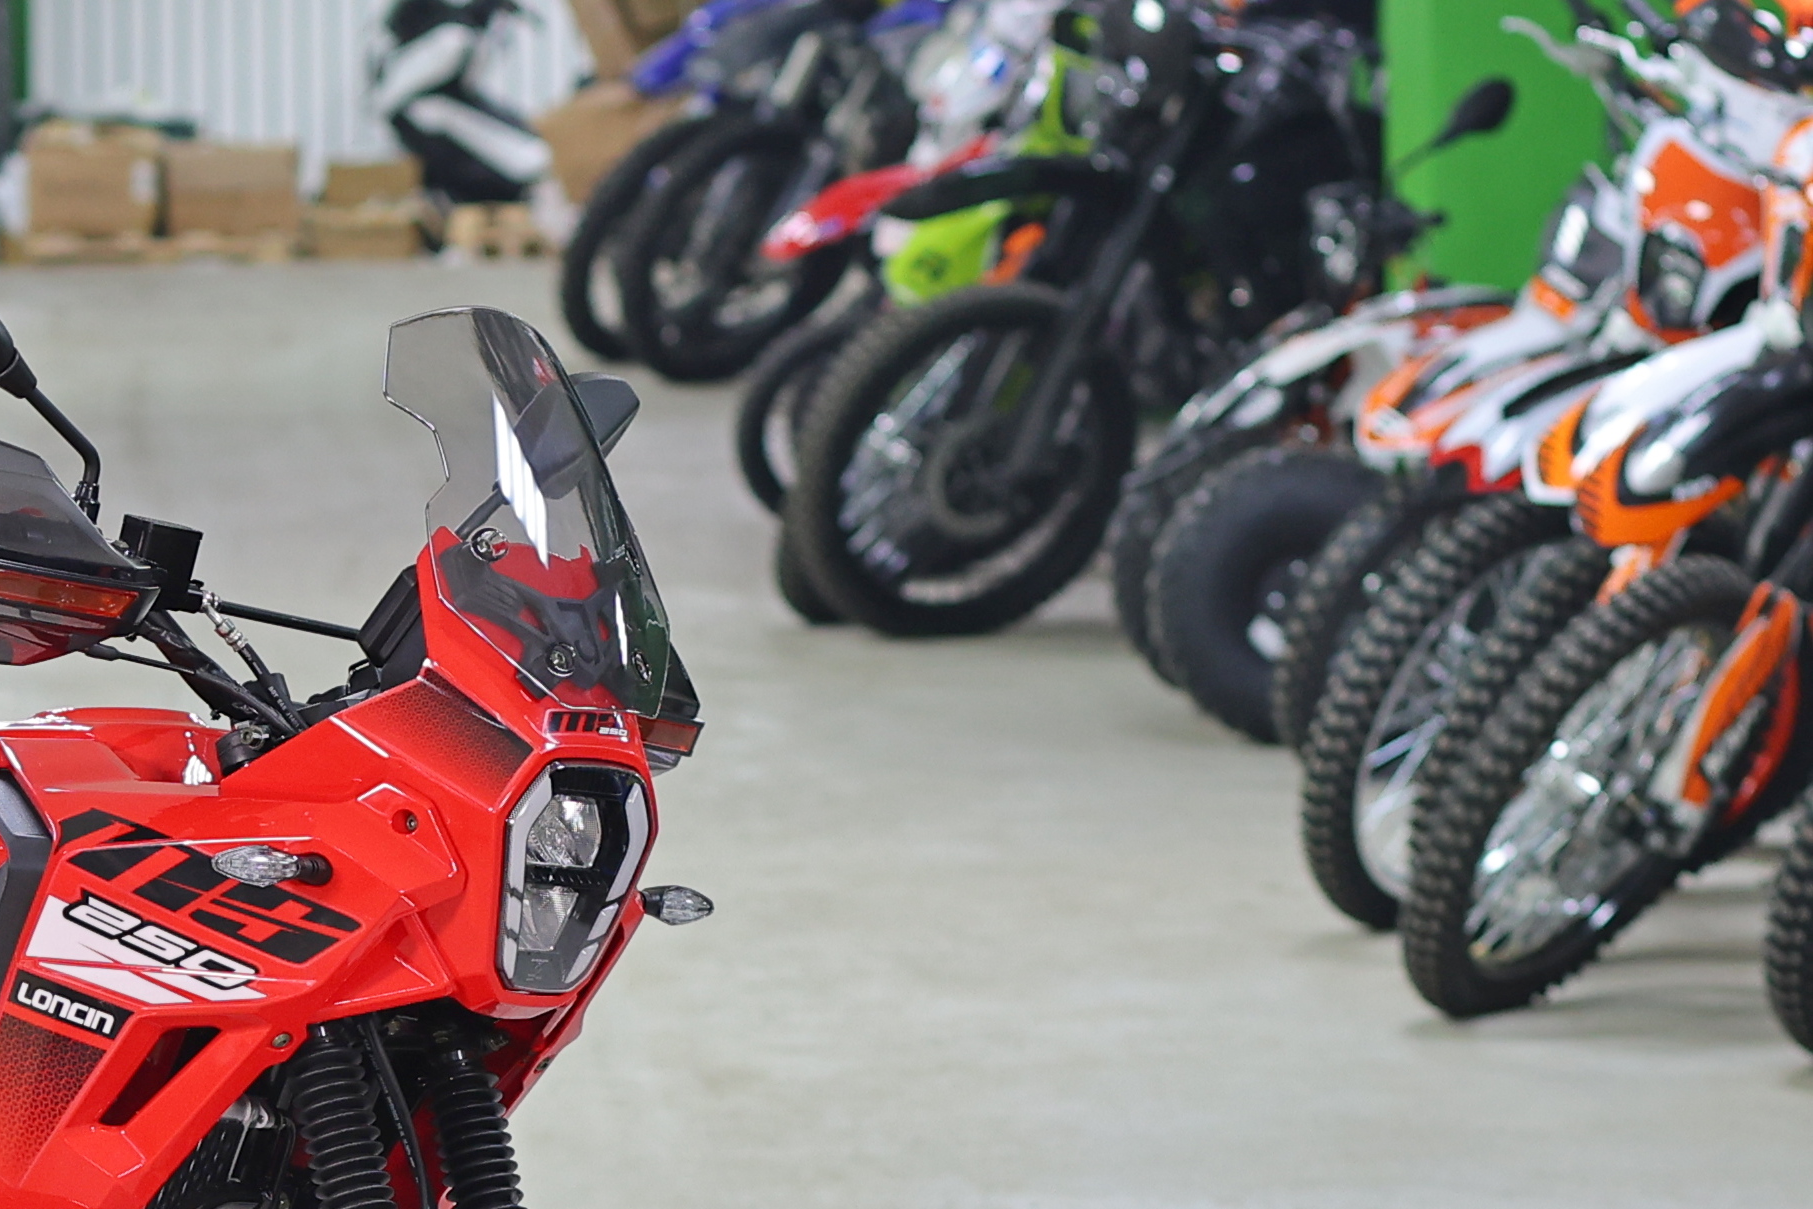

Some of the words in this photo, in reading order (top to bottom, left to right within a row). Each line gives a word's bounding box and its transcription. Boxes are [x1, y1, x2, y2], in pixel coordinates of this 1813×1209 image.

[598, 725, 629, 738] 250
[63, 889, 260, 991] 250
[16, 981, 116, 1036] LONCIN
